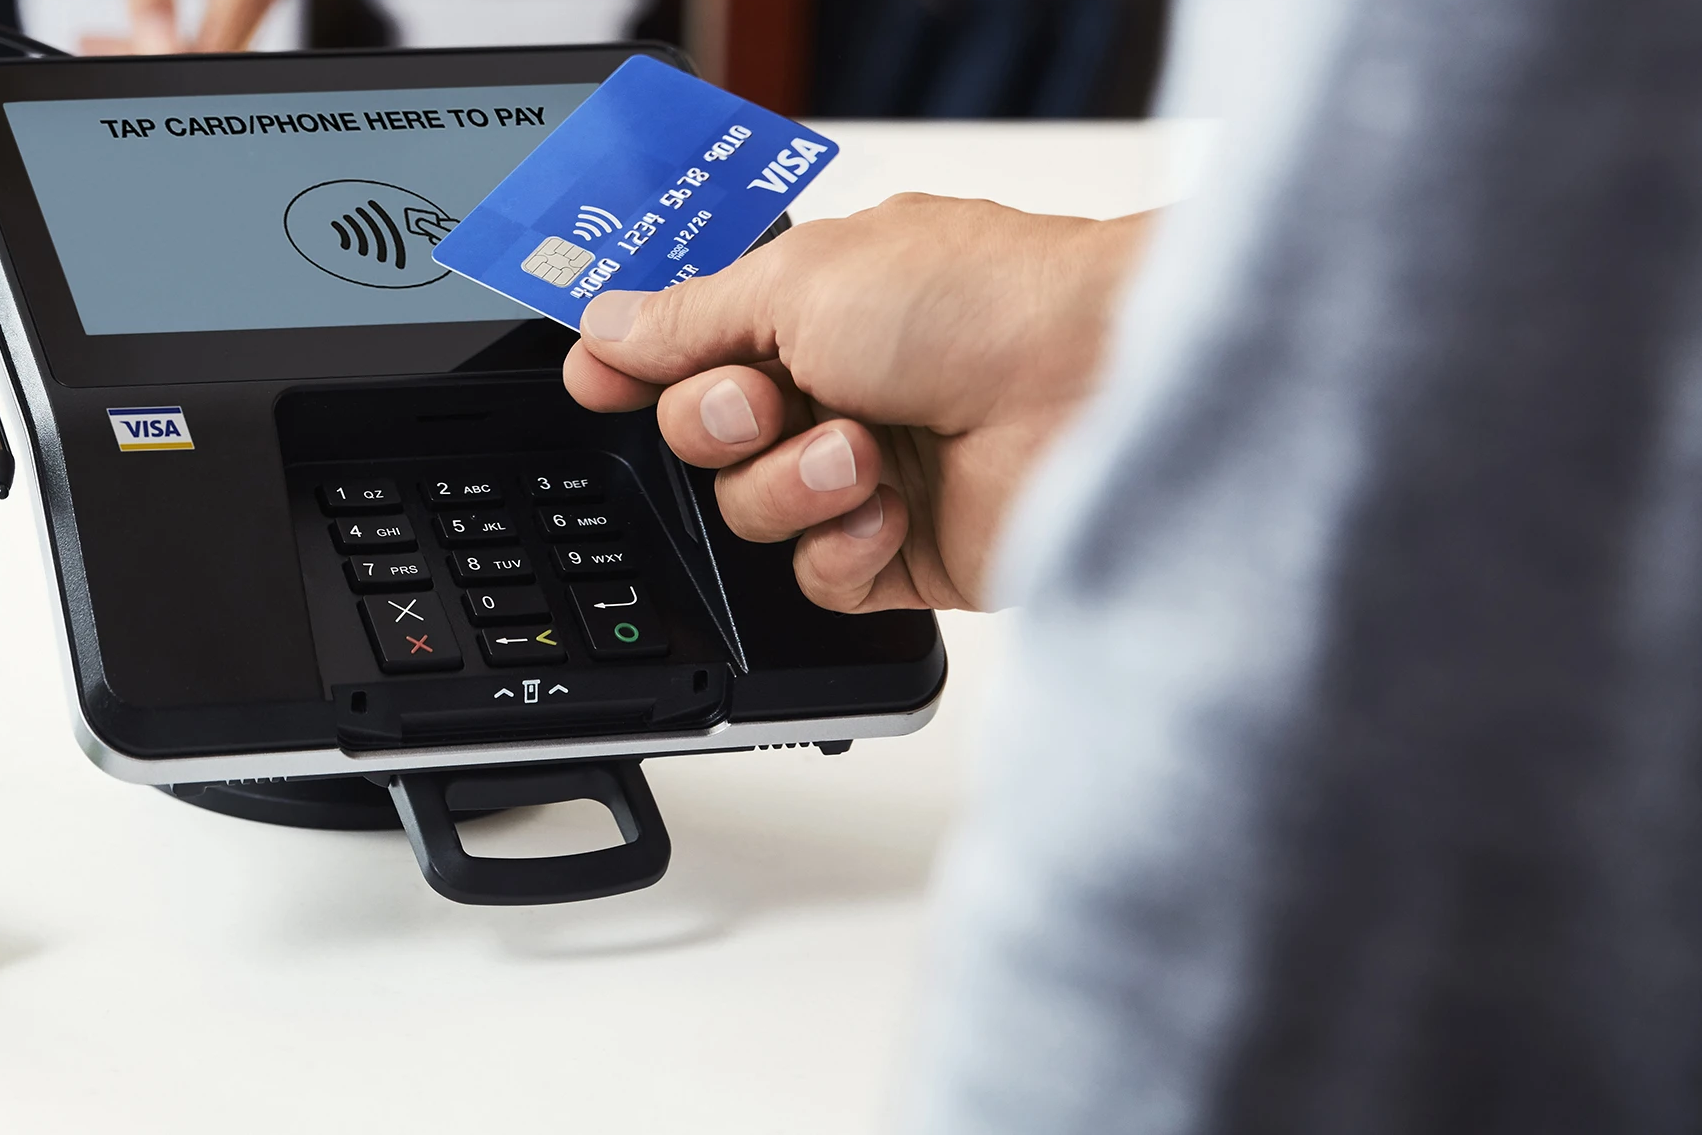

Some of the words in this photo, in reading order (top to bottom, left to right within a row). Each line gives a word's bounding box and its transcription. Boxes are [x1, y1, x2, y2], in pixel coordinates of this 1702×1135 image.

[100, 118, 156, 139] TAP
[164, 112, 361, 137] CARD/PHONE
[363, 110, 445, 131] HERE
[447, 108, 490, 127] TO
[495, 106, 546, 127] PAY
[747, 137, 828, 194] VISA
[570, 258, 621, 298] 4000
[617, 212, 666, 256] 1234
[659, 167, 710, 210] 5678
[703, 124, 753, 162] 9010
[673, 210, 713, 245] 12/20
[667, 243, 684, 259] GOOD
[673, 247, 690, 261] THRU
[119, 419, 182, 438] VISA
[436, 482, 451, 495] 2
[463, 484, 491, 495] ABC
[537, 477, 551, 490] 3
[563, 479, 589, 489] DEF
[336, 487, 347, 500] 1
[363, 490, 384, 499] QZ
[452, 519, 465, 533] 5
[482, 522, 506, 532] JKL
[553, 514, 567, 527] 6
[577, 516, 607, 527] MNO
[349, 525, 363, 538] 4
[376, 527, 401, 537] GHI
[467, 557, 481, 571] 8
[493, 559, 521, 570] TUV
[568, 551, 582, 565] 9
[591, 553, 623, 564] WXY
[362, 562, 375, 576] 7
[390, 565, 419, 576] PRS
[481, 595, 495, 609] 0
